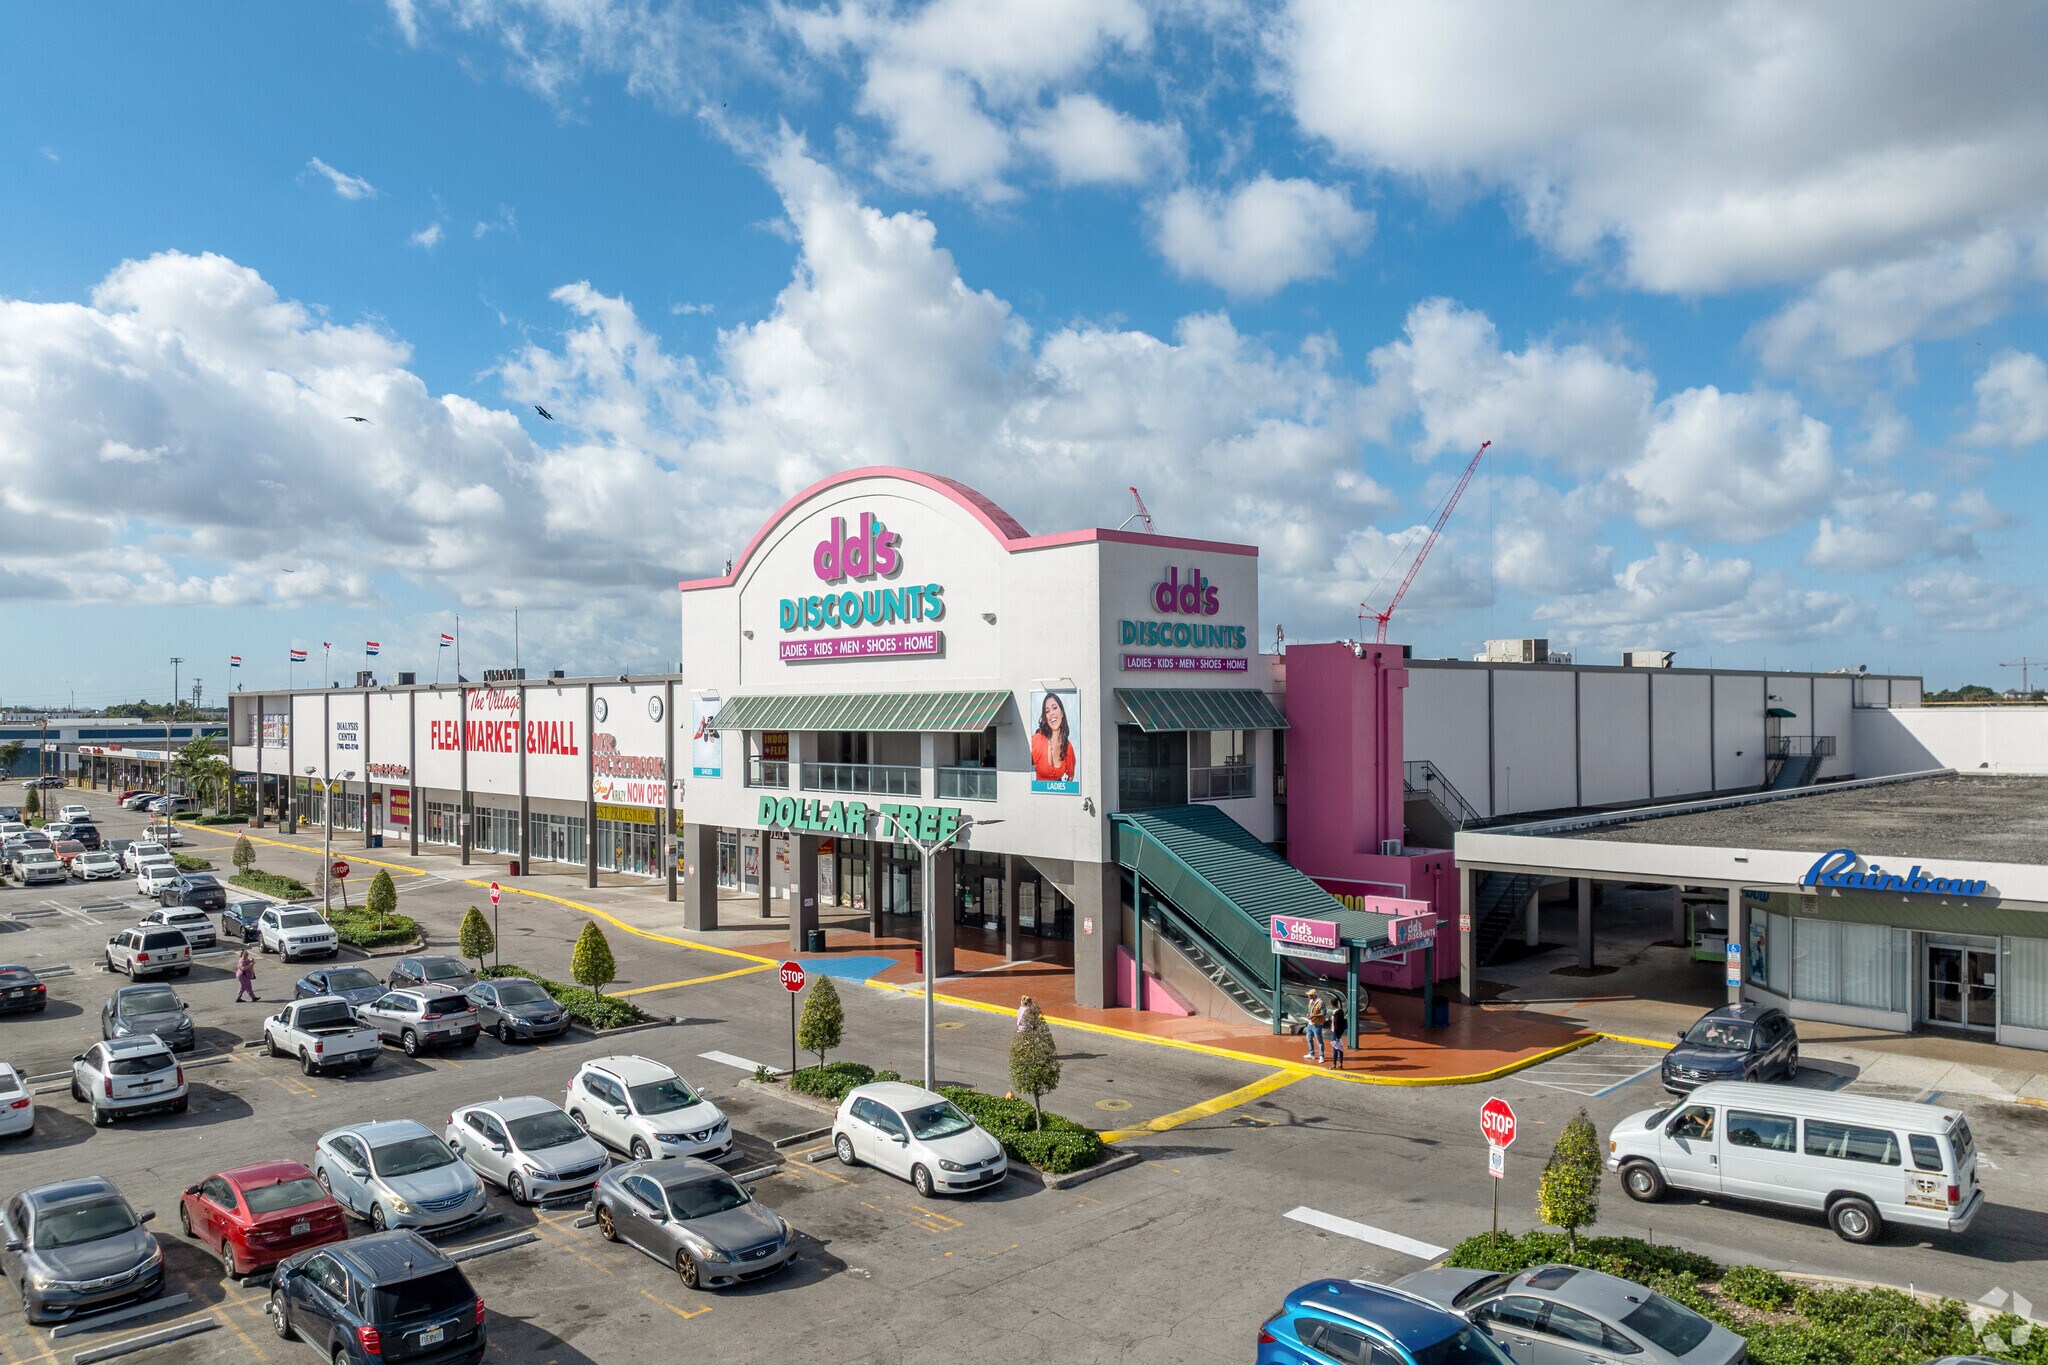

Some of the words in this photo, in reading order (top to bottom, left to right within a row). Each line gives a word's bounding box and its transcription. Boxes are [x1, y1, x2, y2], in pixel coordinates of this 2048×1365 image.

[813, 511, 897, 581] dd's
[1153, 566, 1220, 615] dd's
[779, 583, 943, 630] DISCOUNTS
[1121, 620, 1247, 649] DISCOUNTS
[781, 644, 807, 658] LADIES
[814, 642, 833, 656] KIDS
[839, 640, 860, 653] MEN
[866, 637, 897, 652] SHOES
[904, 635, 934, 650] HOME
[1127, 658, 1152, 668] LADIES
[1157, 658, 1174, 668] KIDS
[1179, 659, 1195, 669] MEN
[1200, 659, 1222, 669] SHOES
[1226, 659, 1246, 669] HOME
[467, 688, 485, 712] The
[486, 689, 520, 717] Village
[336, 722, 359, 731] DIALYSIS
[338, 733, 357, 741] CENTER
[431, 720, 461, 750] FLEA
[466, 720, 520, 753] MARKET
[764, 734, 788, 744] INDOO
[770, 746, 787, 755] FLEA
[1046, 782, 1066, 790] LADIES
[627, 782, 645, 803] NOW
[647, 783, 666, 805] OPEN
[596, 805, 608, 819] EST
[610, 806, 633, 821] PRICES
[758, 796, 868, 835] DOLLAR
[880, 803, 962, 842] TREE
[332, 865, 349, 875] STOP
[1804, 848, 1987, 896] Rainbow
[1290, 921, 1312, 935] dd's
[1407, 928, 1436, 941] DISCOUNTS
[1290, 933, 1333, 946] DISCOUNTS
[1288, 949, 1328, 959] ENTRANCE
[1378, 943, 1417, 957] ENTRANCE
[781, 969, 804, 983] STOP
[1483, 1110, 1514, 1135] STOP
